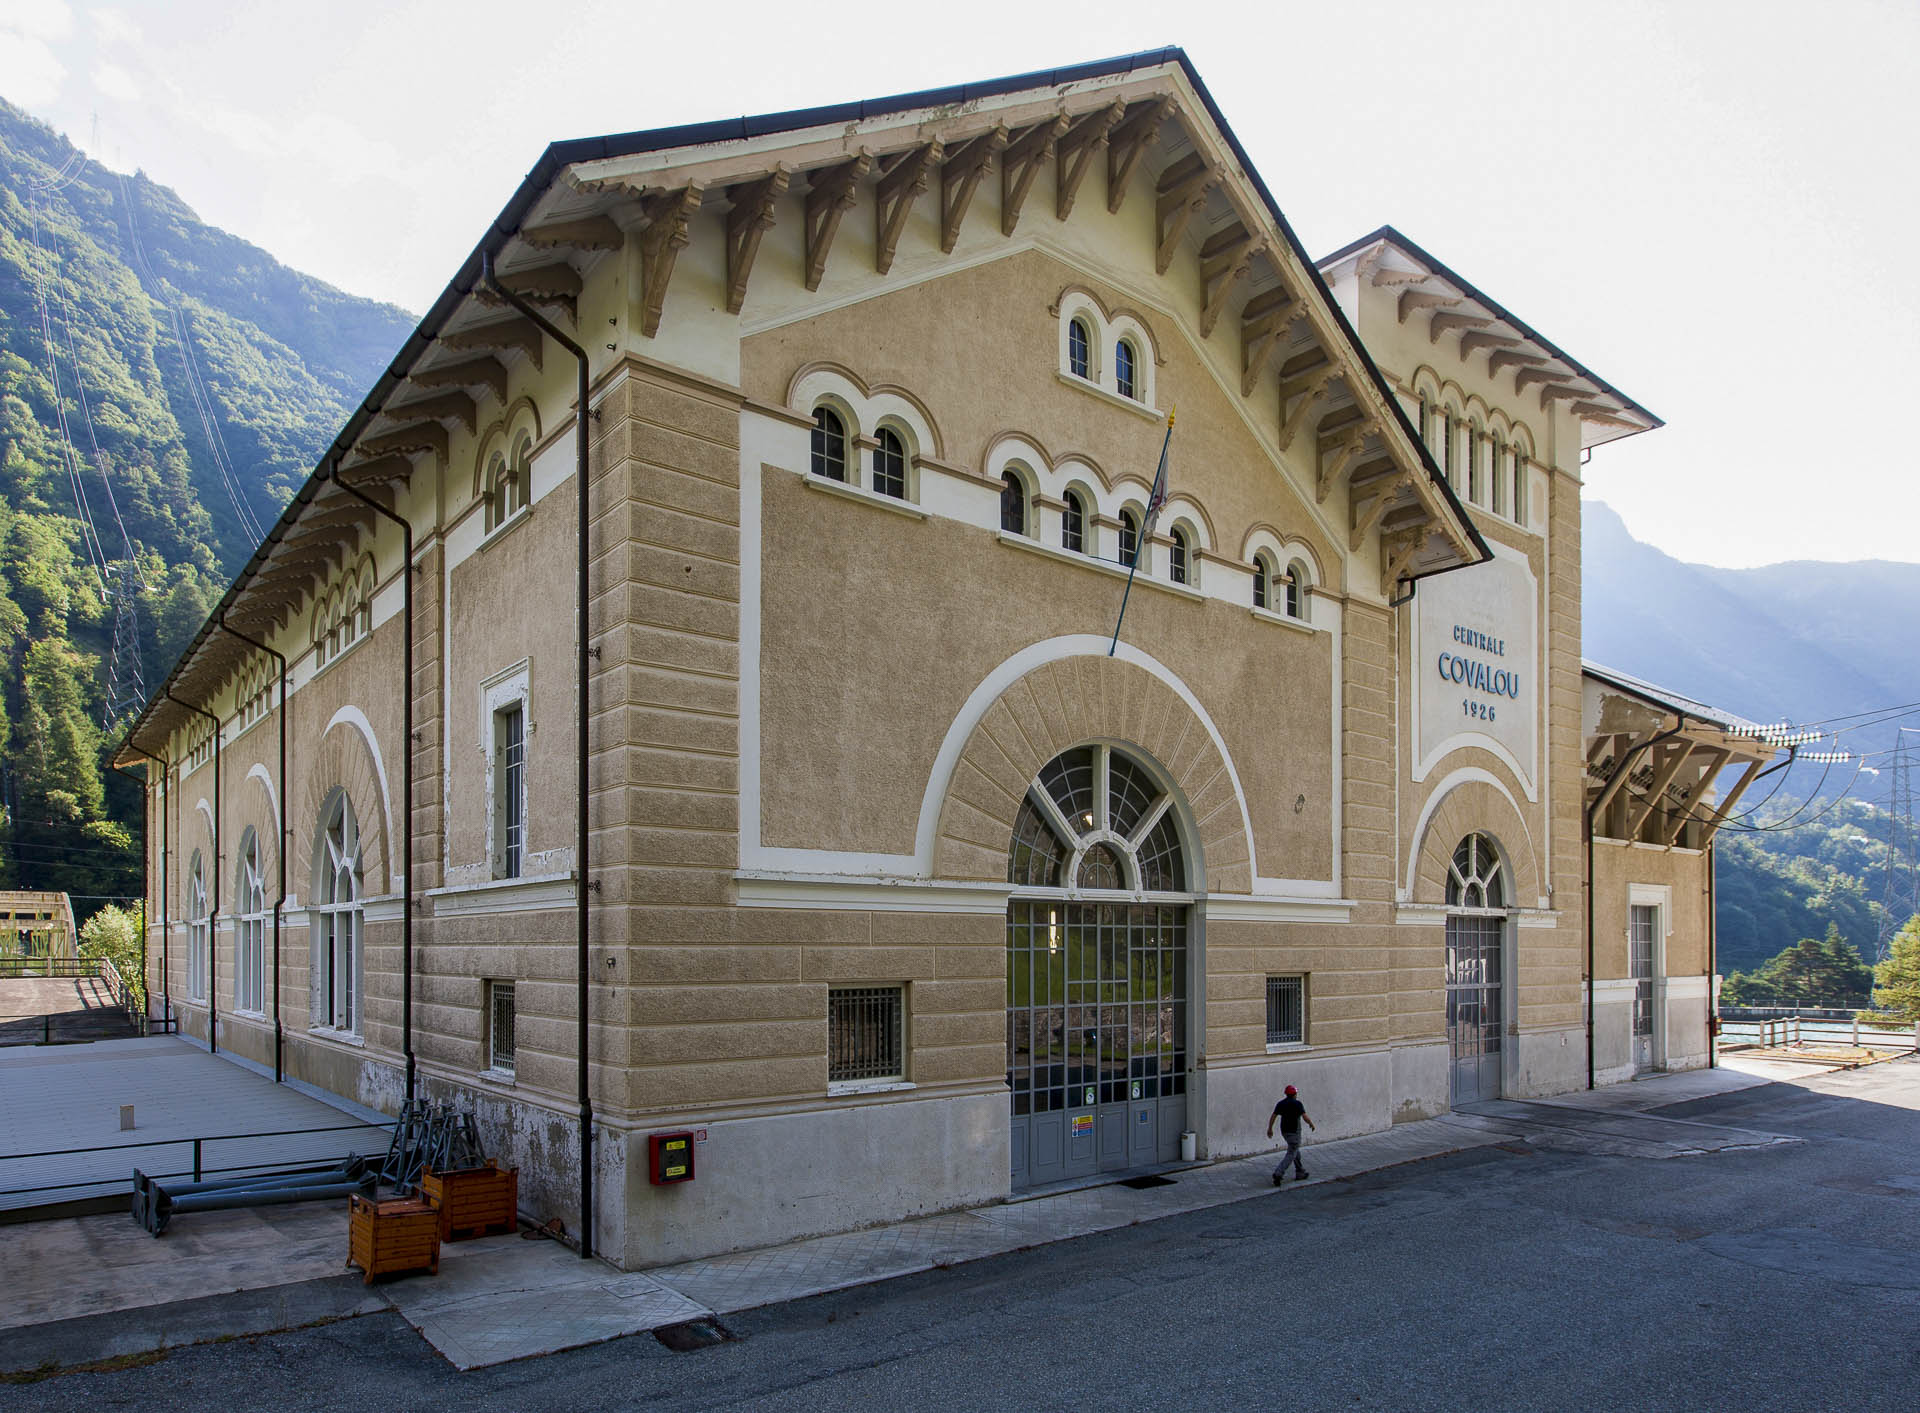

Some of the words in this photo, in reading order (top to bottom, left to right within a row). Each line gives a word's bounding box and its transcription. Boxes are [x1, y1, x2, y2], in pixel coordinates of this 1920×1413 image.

[1453, 624, 1504, 656] CENTRALE
[1438, 652, 1519, 699] COVALOU
[1463, 699, 1496, 722] 1926
